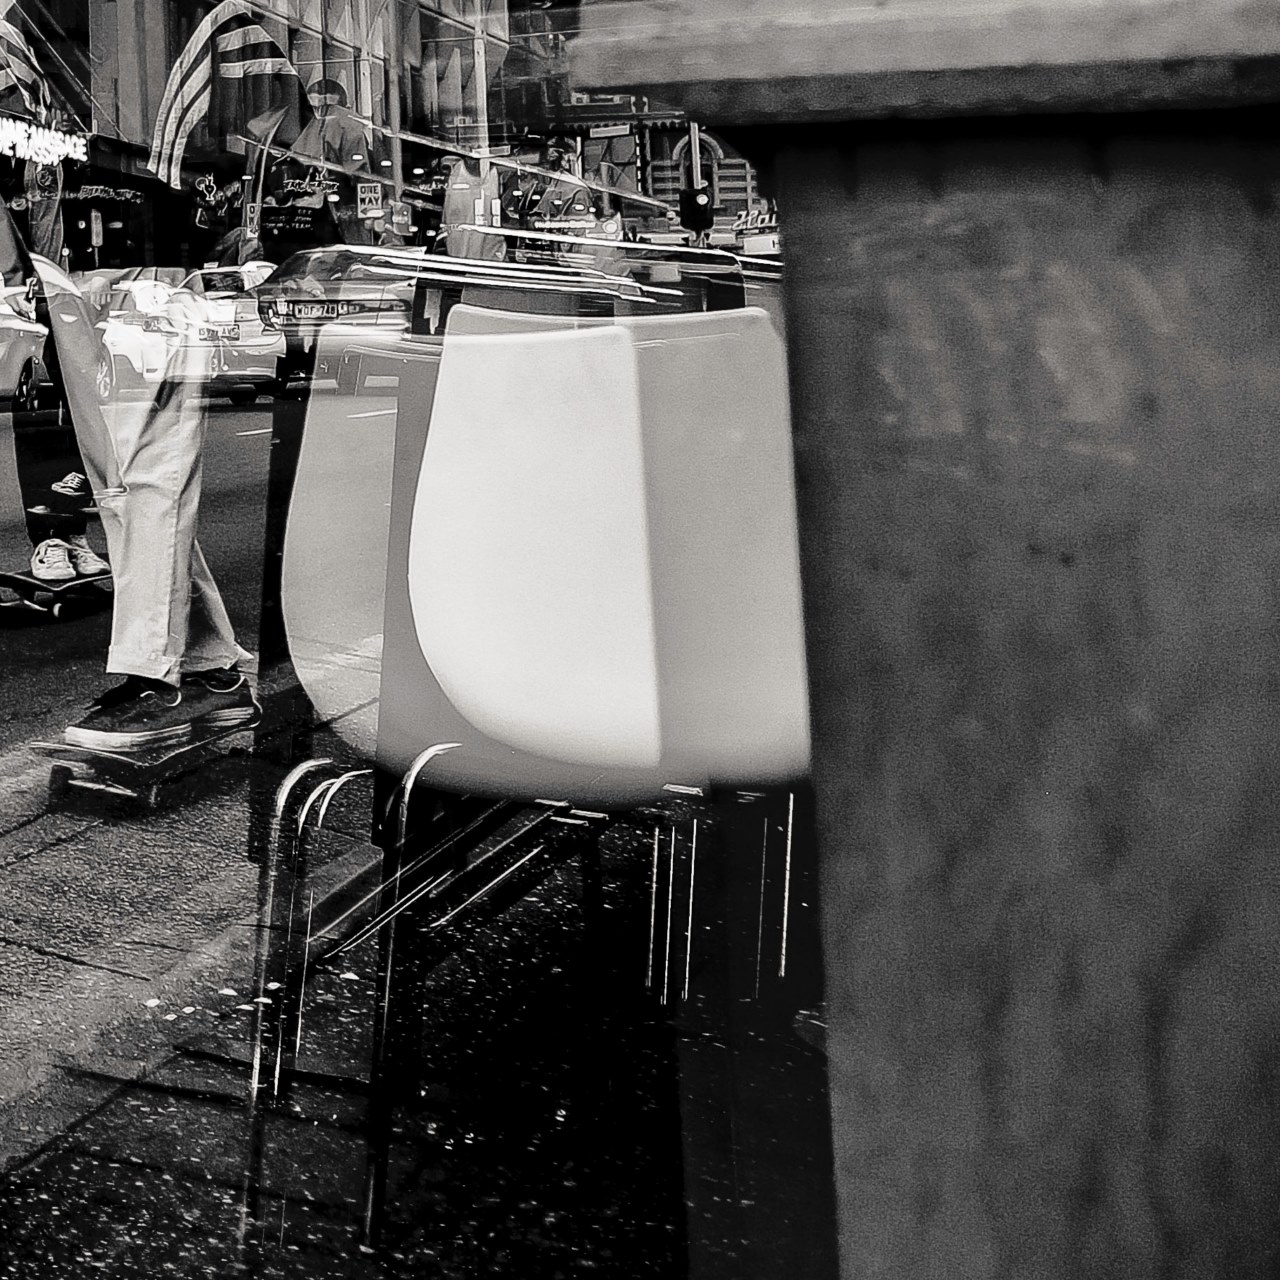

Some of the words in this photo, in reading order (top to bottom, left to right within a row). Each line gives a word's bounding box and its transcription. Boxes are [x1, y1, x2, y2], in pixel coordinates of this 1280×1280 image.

[359, 184, 380, 196] ONE
[359, 197, 380, 208] WAY
[297, 305, 317, 317] WOF
[319, 304, 336, 316] 748
